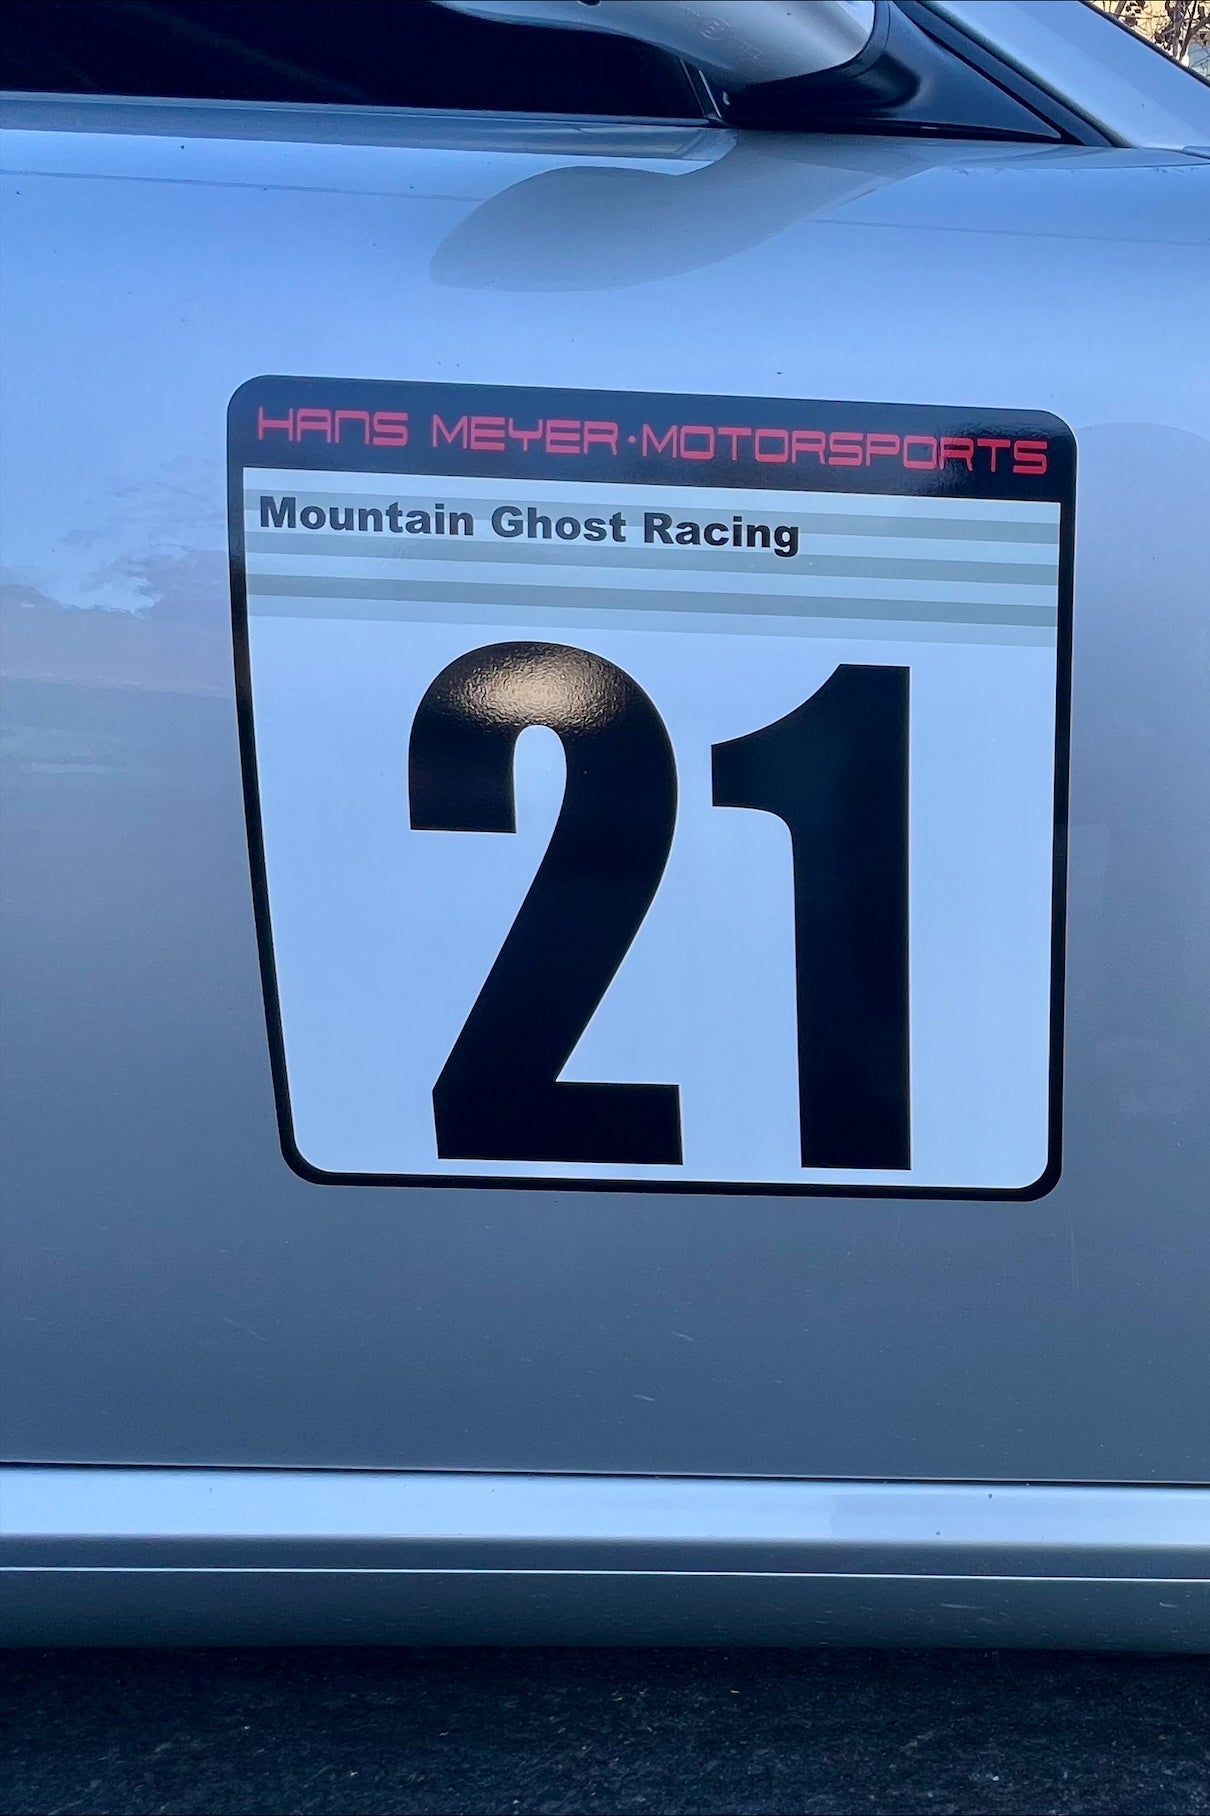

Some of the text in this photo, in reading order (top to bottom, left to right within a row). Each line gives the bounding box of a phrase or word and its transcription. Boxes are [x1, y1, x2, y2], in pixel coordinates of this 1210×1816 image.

[260, 408, 409, 447] HANS
[258, 495, 801, 558] Mountain Ghost Racing
[408, 641, 912, 1171] 21
